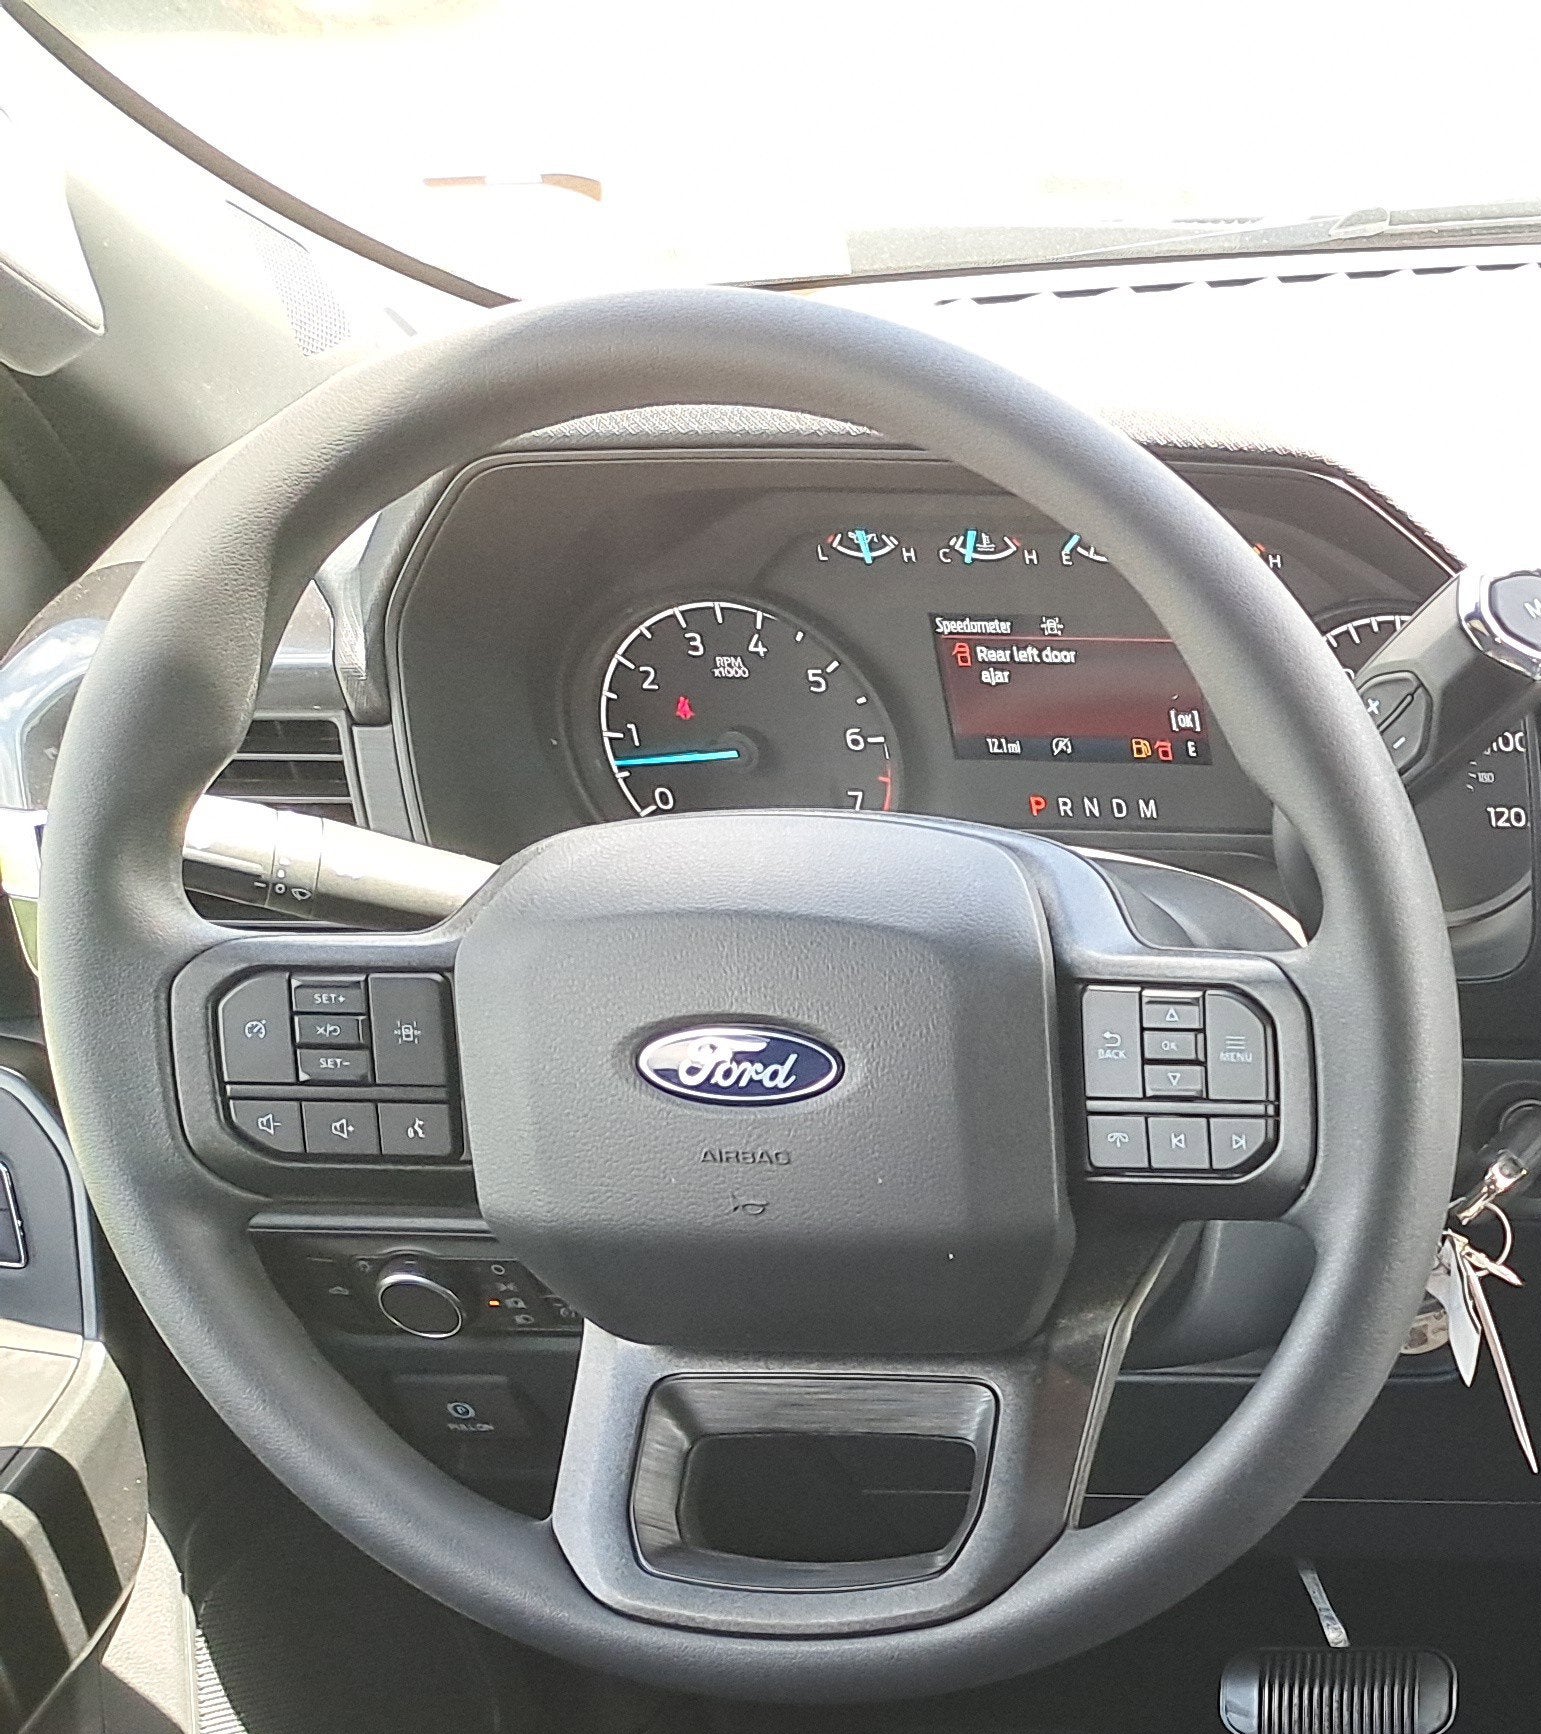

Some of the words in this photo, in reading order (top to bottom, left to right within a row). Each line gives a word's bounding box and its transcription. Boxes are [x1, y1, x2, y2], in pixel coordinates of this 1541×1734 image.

[818, 545, 828, 560] L
[903, 548, 916, 562] H
[939, 549, 951, 562] C
[1024, 550, 1038, 564] H
[1062, 551, 1072, 565] E
[1268, 554, 1282, 568] H
[935, 618, 1011, 634] Speedometer
[684, 632, 704, 656] 3
[748, 633, 768, 658] 4
[715, 656, 743, 668] RPM
[976, 646, 1010, 662] Rear
[1013, 646, 1040, 662] left
[1043, 646, 1076, 663] door
[639, 666, 659, 690] 2
[807, 669, 827, 693] 5
[981, 670, 1010, 685] ajar
[626, 723, 640, 746] 1
[845, 728, 865, 751] 6
[654, 787, 674, 810] 0
[847, 791, 863, 811] 7
[1030, 796, 1046, 816] P
[1058, 797, 1073, 817] R
[1084, 797, 1100, 817] N
[1112, 798, 1127, 818] D
[1139, 799, 1157, 818] M
[1487, 807, 1526, 827] 120
[678, 1036, 797, 1089] Ford
[1098, 1049, 1127, 1060] BACK
[1219, 1052, 1252, 1063] MENU
